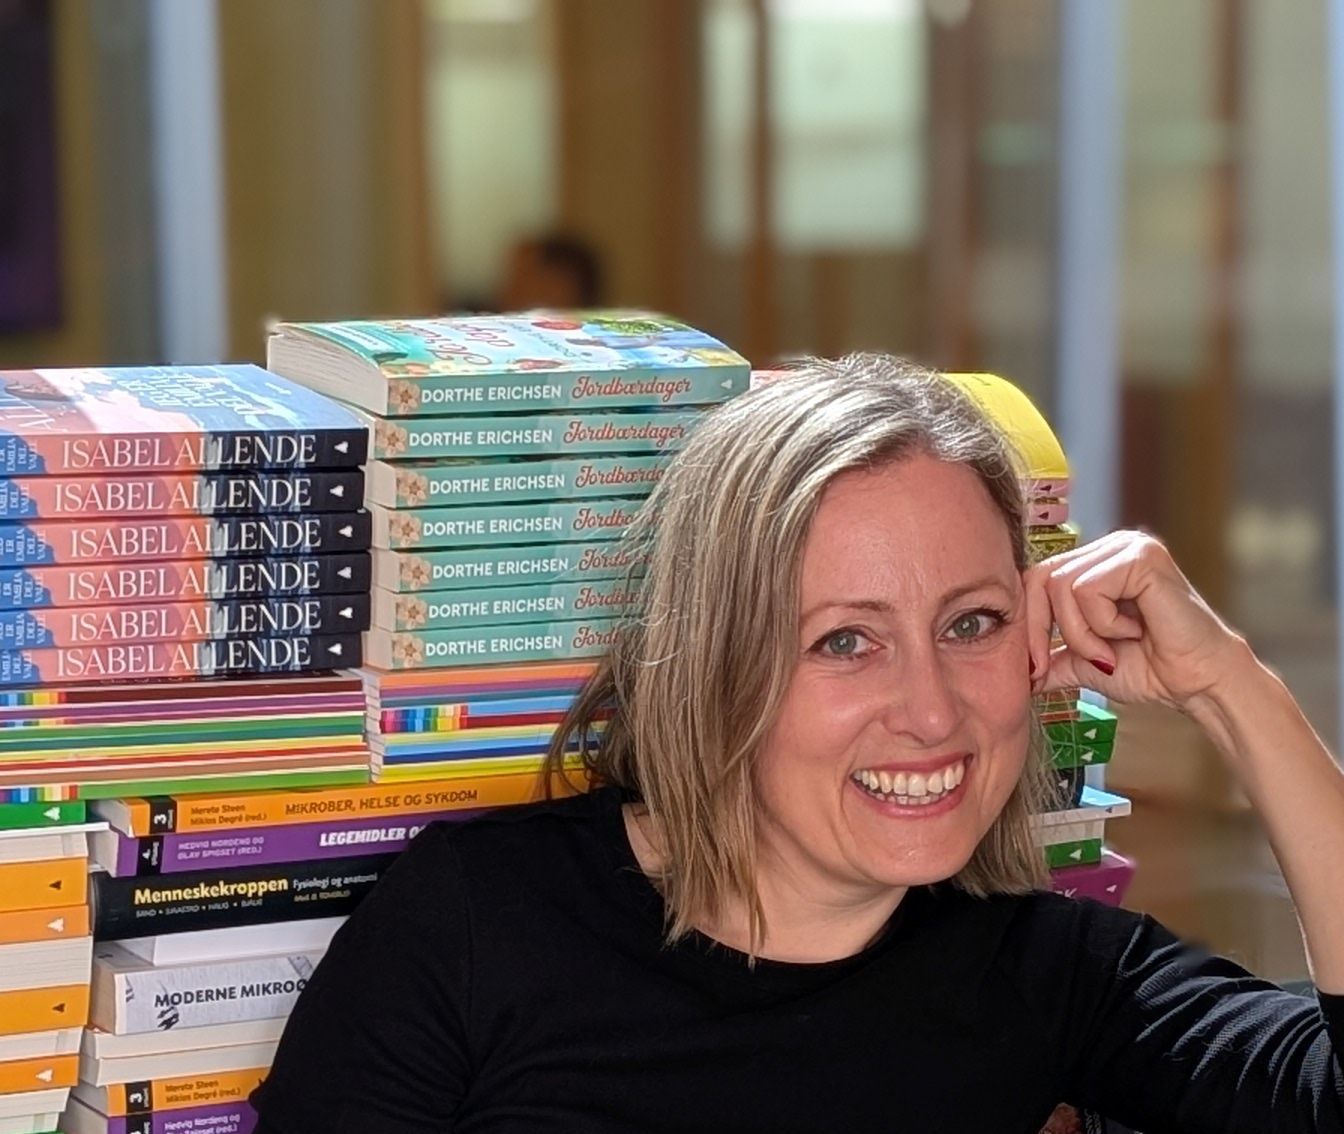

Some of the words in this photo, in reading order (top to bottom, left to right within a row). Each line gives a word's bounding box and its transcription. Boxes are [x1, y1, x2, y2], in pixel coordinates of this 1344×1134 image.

[421, 387, 483, 403] DORTHE
[488, 384, 561, 401] ERICHSEN
[409, 432, 473, 447] DORTHE
[477, 429, 553, 445] ERICHSEN
[63, 437, 170, 468] ISABEL
[175, 434, 316, 466] ALLENDE
[55, 482, 164, 512] ISABEL
[169, 477, 311, 509] ALLENDE
[429, 478, 490, 494] DORTHE
[494, 474, 565, 491] ERICHSEN
[71, 526, 177, 557] ISABEL
[182, 520, 321, 555] ALLENDE
[423, 521, 484, 536] DORTHE
[488, 517, 562, 534] ERICHSEN
[68, 570, 175, 600] ISABEL
[180, 561, 321, 597] ALLENDE
[433, 563, 494, 578] DORTHE
[498, 559, 568, 575] ERICHSEN
[429, 603, 490, 618] DORTHE
[494, 597, 565, 615] ERICHSEN
[71, 612, 177, 642] ISABEL
[182, 602, 321, 639] ALLENDE
[58, 647, 165, 678] ISABEL
[170, 638, 310, 675] ALLENDE
[426, 642, 488, 657] DORTHE
[491, 636, 562, 654] ERICHSEN
[285, 799, 356, 815] MIKROBER,
[359, 797, 400, 810] HELSE
[403, 794, 421, 806] OG
[425, 790, 477, 805] SYKDOM
[320, 828, 405, 846] LEGEMIDLER
[134, 877, 288, 905] Menneskekroppen
[331, 877, 342, 888] og
[155, 986, 237, 1008] MODERNE
[240, 978, 306, 998] MIKROØ
